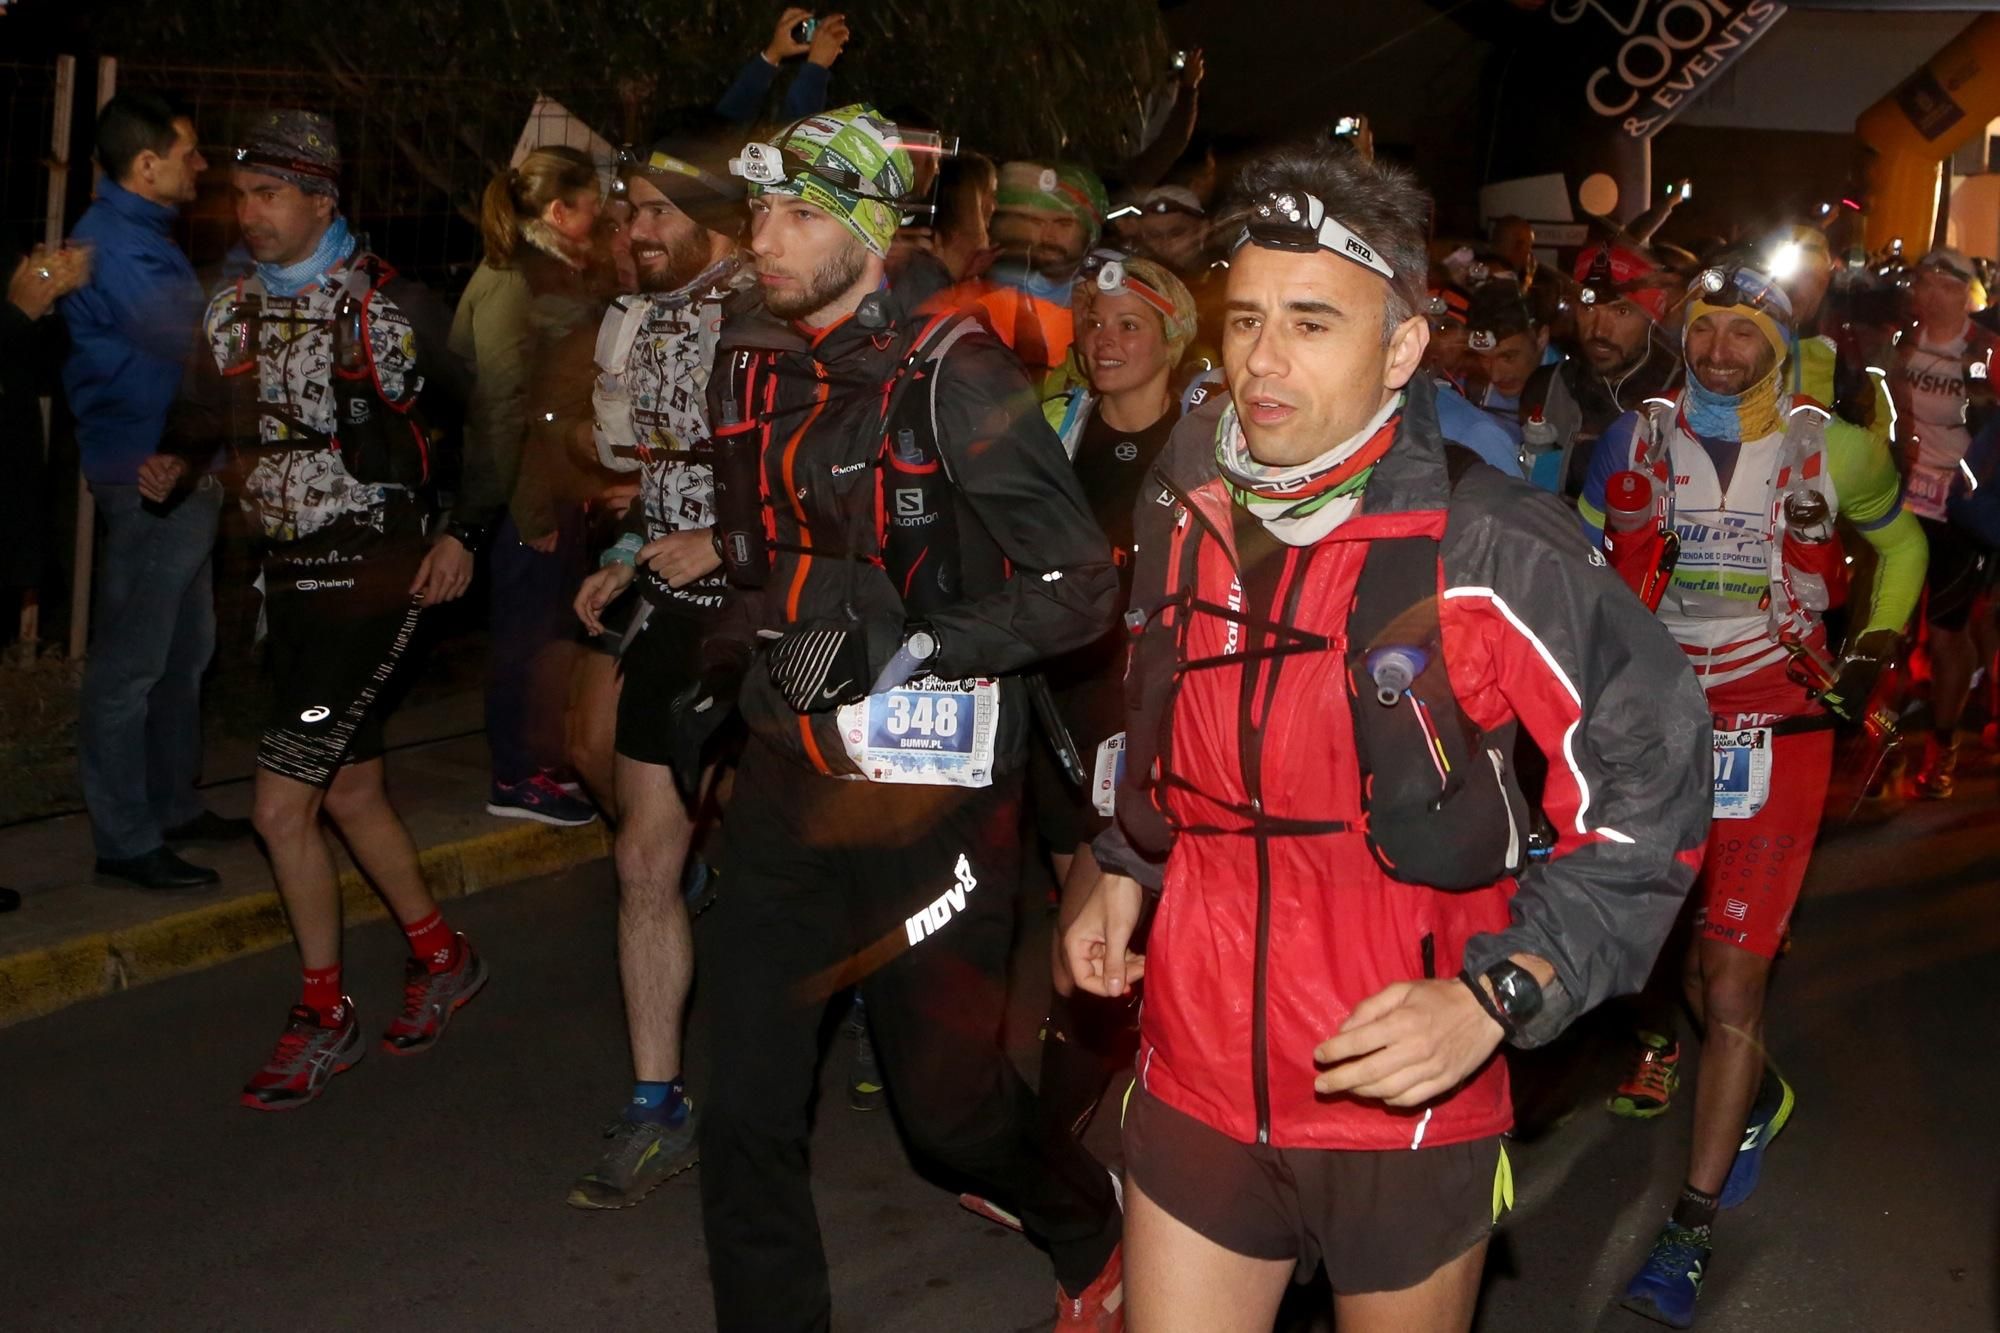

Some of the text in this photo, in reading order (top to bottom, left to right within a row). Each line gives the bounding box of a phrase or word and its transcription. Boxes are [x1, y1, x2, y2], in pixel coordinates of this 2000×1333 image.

[1652, 2, 1775, 110] EVENTS
[1345, 238, 1373, 263] PETZL
[1678, 551, 1703, 561] TIENDA
[1705, 552, 1714, 561] DE
[925, 683, 959, 693] CANARIA
[887, 696, 957, 737] 348
[900, 738, 943, 750] BUMW.PL
